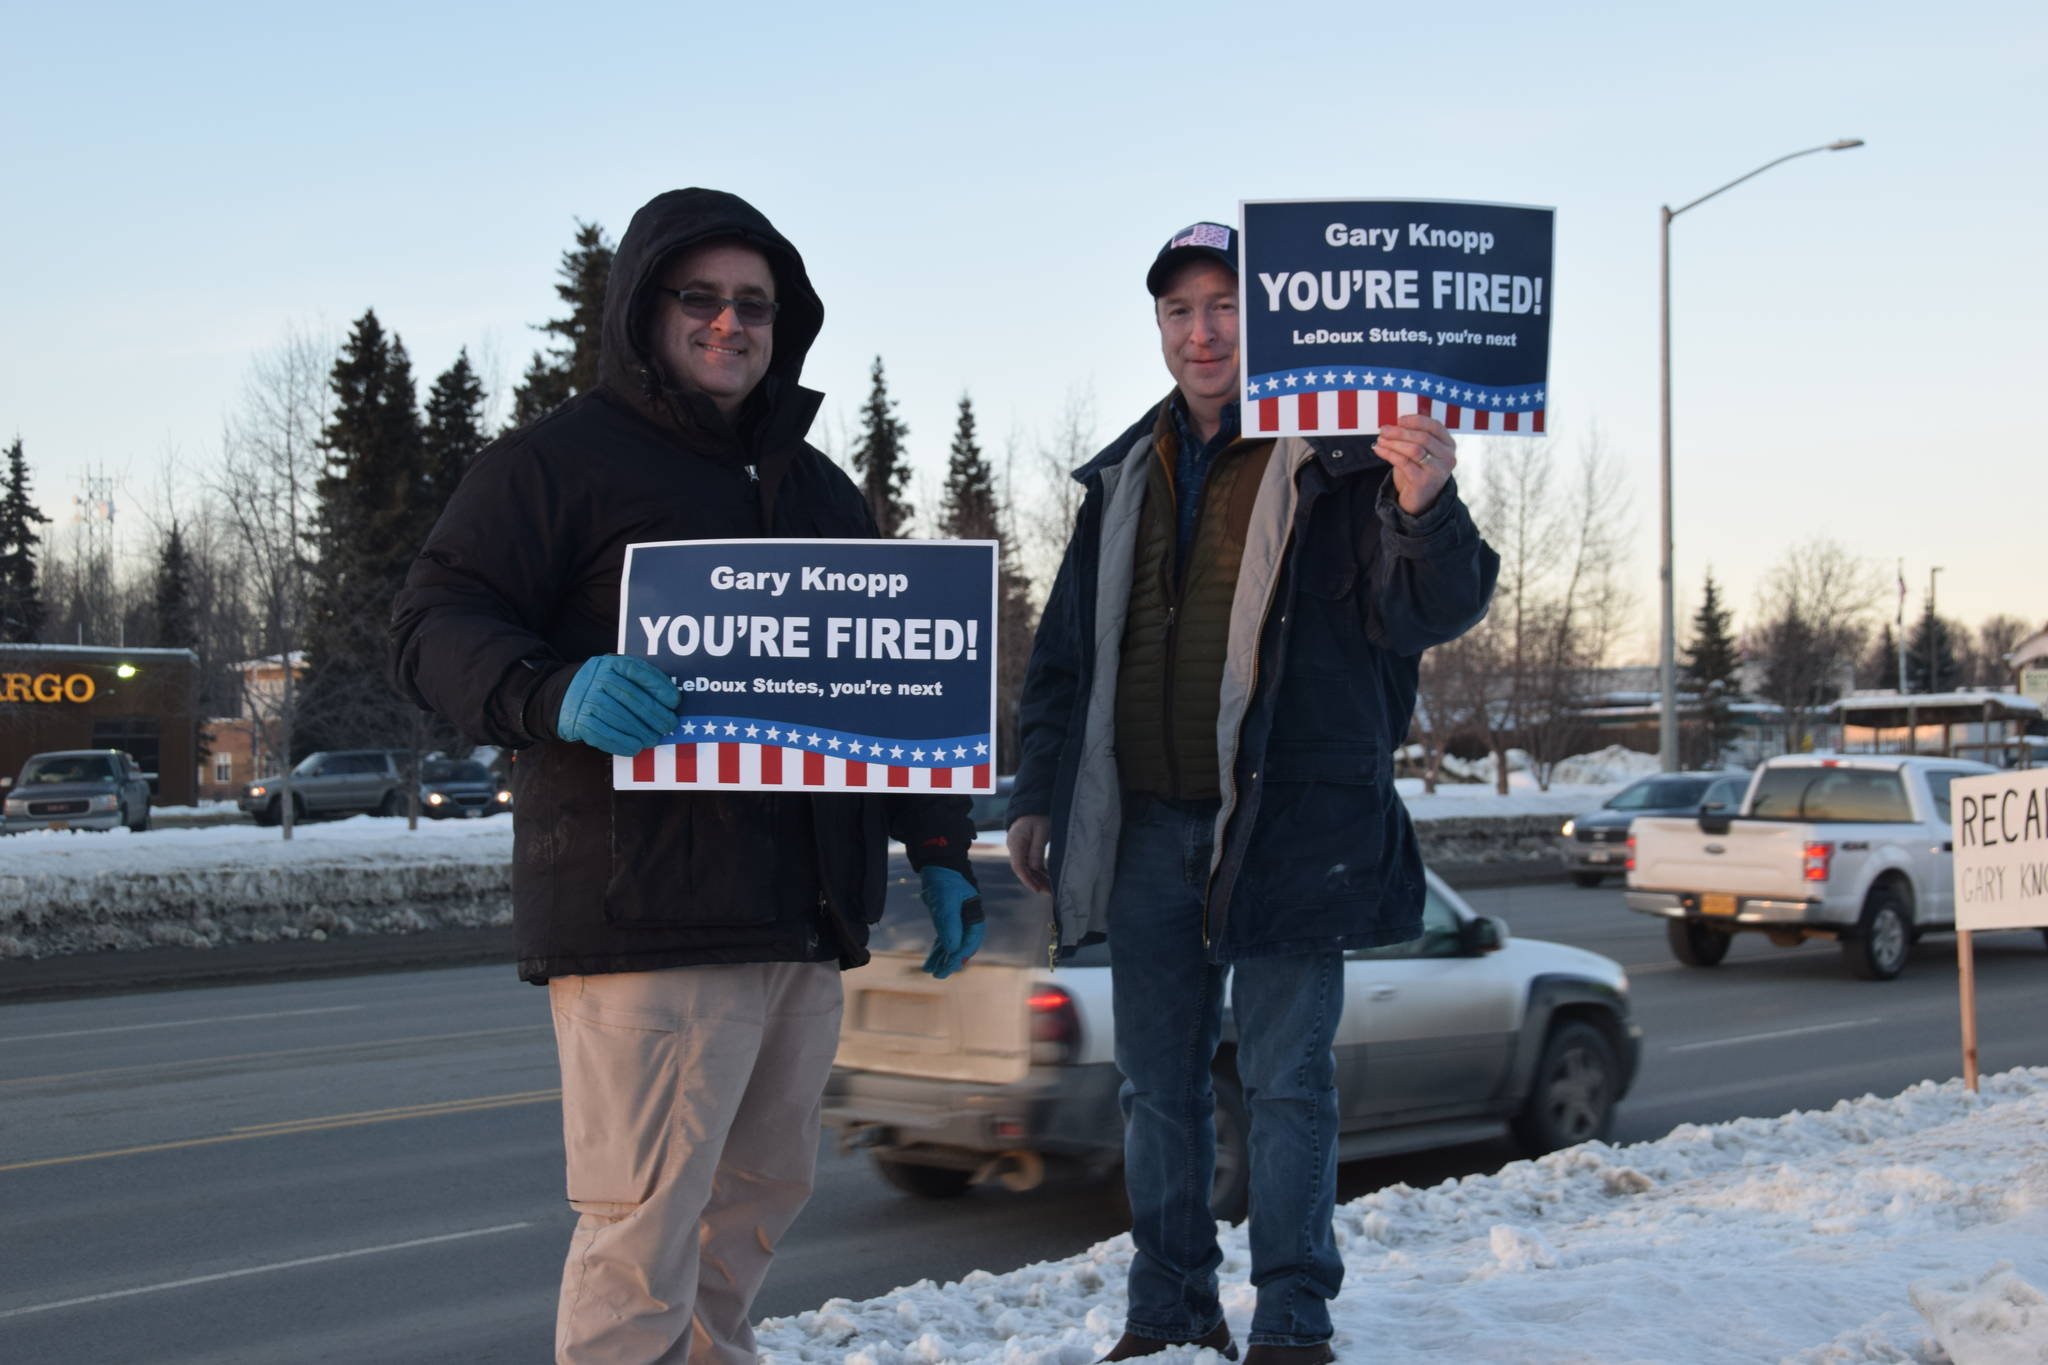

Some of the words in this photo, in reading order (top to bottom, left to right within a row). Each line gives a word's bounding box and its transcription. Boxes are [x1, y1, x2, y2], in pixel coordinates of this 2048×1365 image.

[1325, 223, 1399, 252] Gary
[1409, 223, 1494, 255] Knopp
[1258, 269, 1420, 312] YOU'RE
[1432, 271, 1543, 315] FIRED!
[1293, 329, 1364, 345] LeDoux
[1369, 328, 1433, 345] Stutes,
[1437, 330, 1482, 346] you're
[1486, 333, 1518, 347] next
[710, 565, 791, 597] Gary
[801, 566, 909, 598] Knopp
[638, 614, 810, 658] YOU'RE
[826, 617, 979, 661] FIRED!
[0, 673, 96, 703] RGO
[752, 677, 824, 697] Stutes,
[830, 680, 892, 698] you're
[897, 680, 943, 696] next
[1962, 865, 2006, 903] GARY
